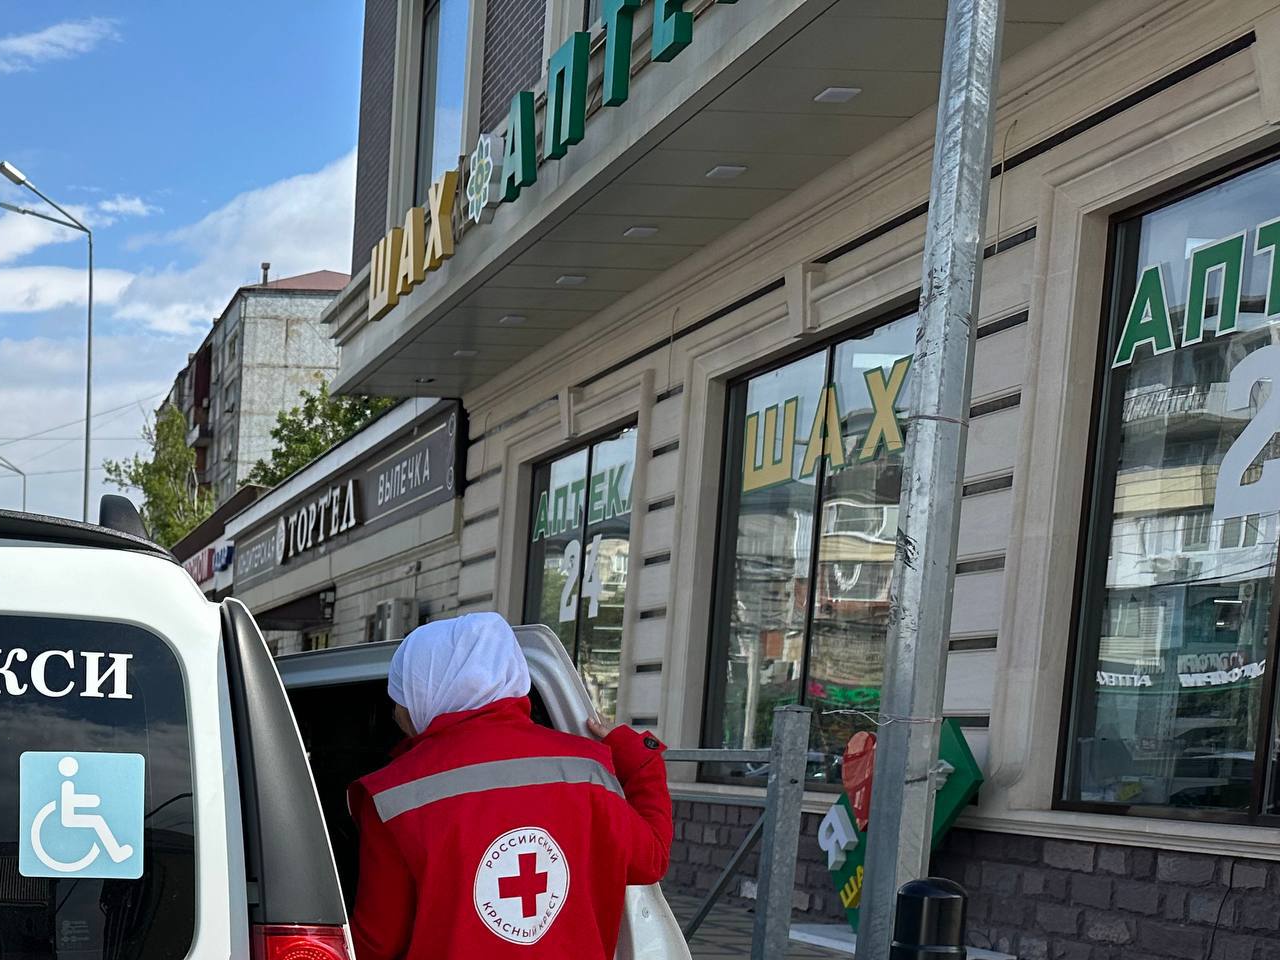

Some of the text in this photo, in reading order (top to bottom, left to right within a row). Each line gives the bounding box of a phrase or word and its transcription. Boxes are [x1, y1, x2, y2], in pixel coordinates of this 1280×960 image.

[369, 0, 732, 321] ШАХ АПТЕ
[743, 354, 914, 495] ШАХ
[377, 447, 430, 506] ВЫПЕЧКА
[532, 463, 636, 542] АПТЕК
[559, 534, 602, 623] 24
[485, 832, 559, 869] РОССИЙСКИЙ
[483, 893, 560, 938] КРАСНЫЙ КРЕСТ
